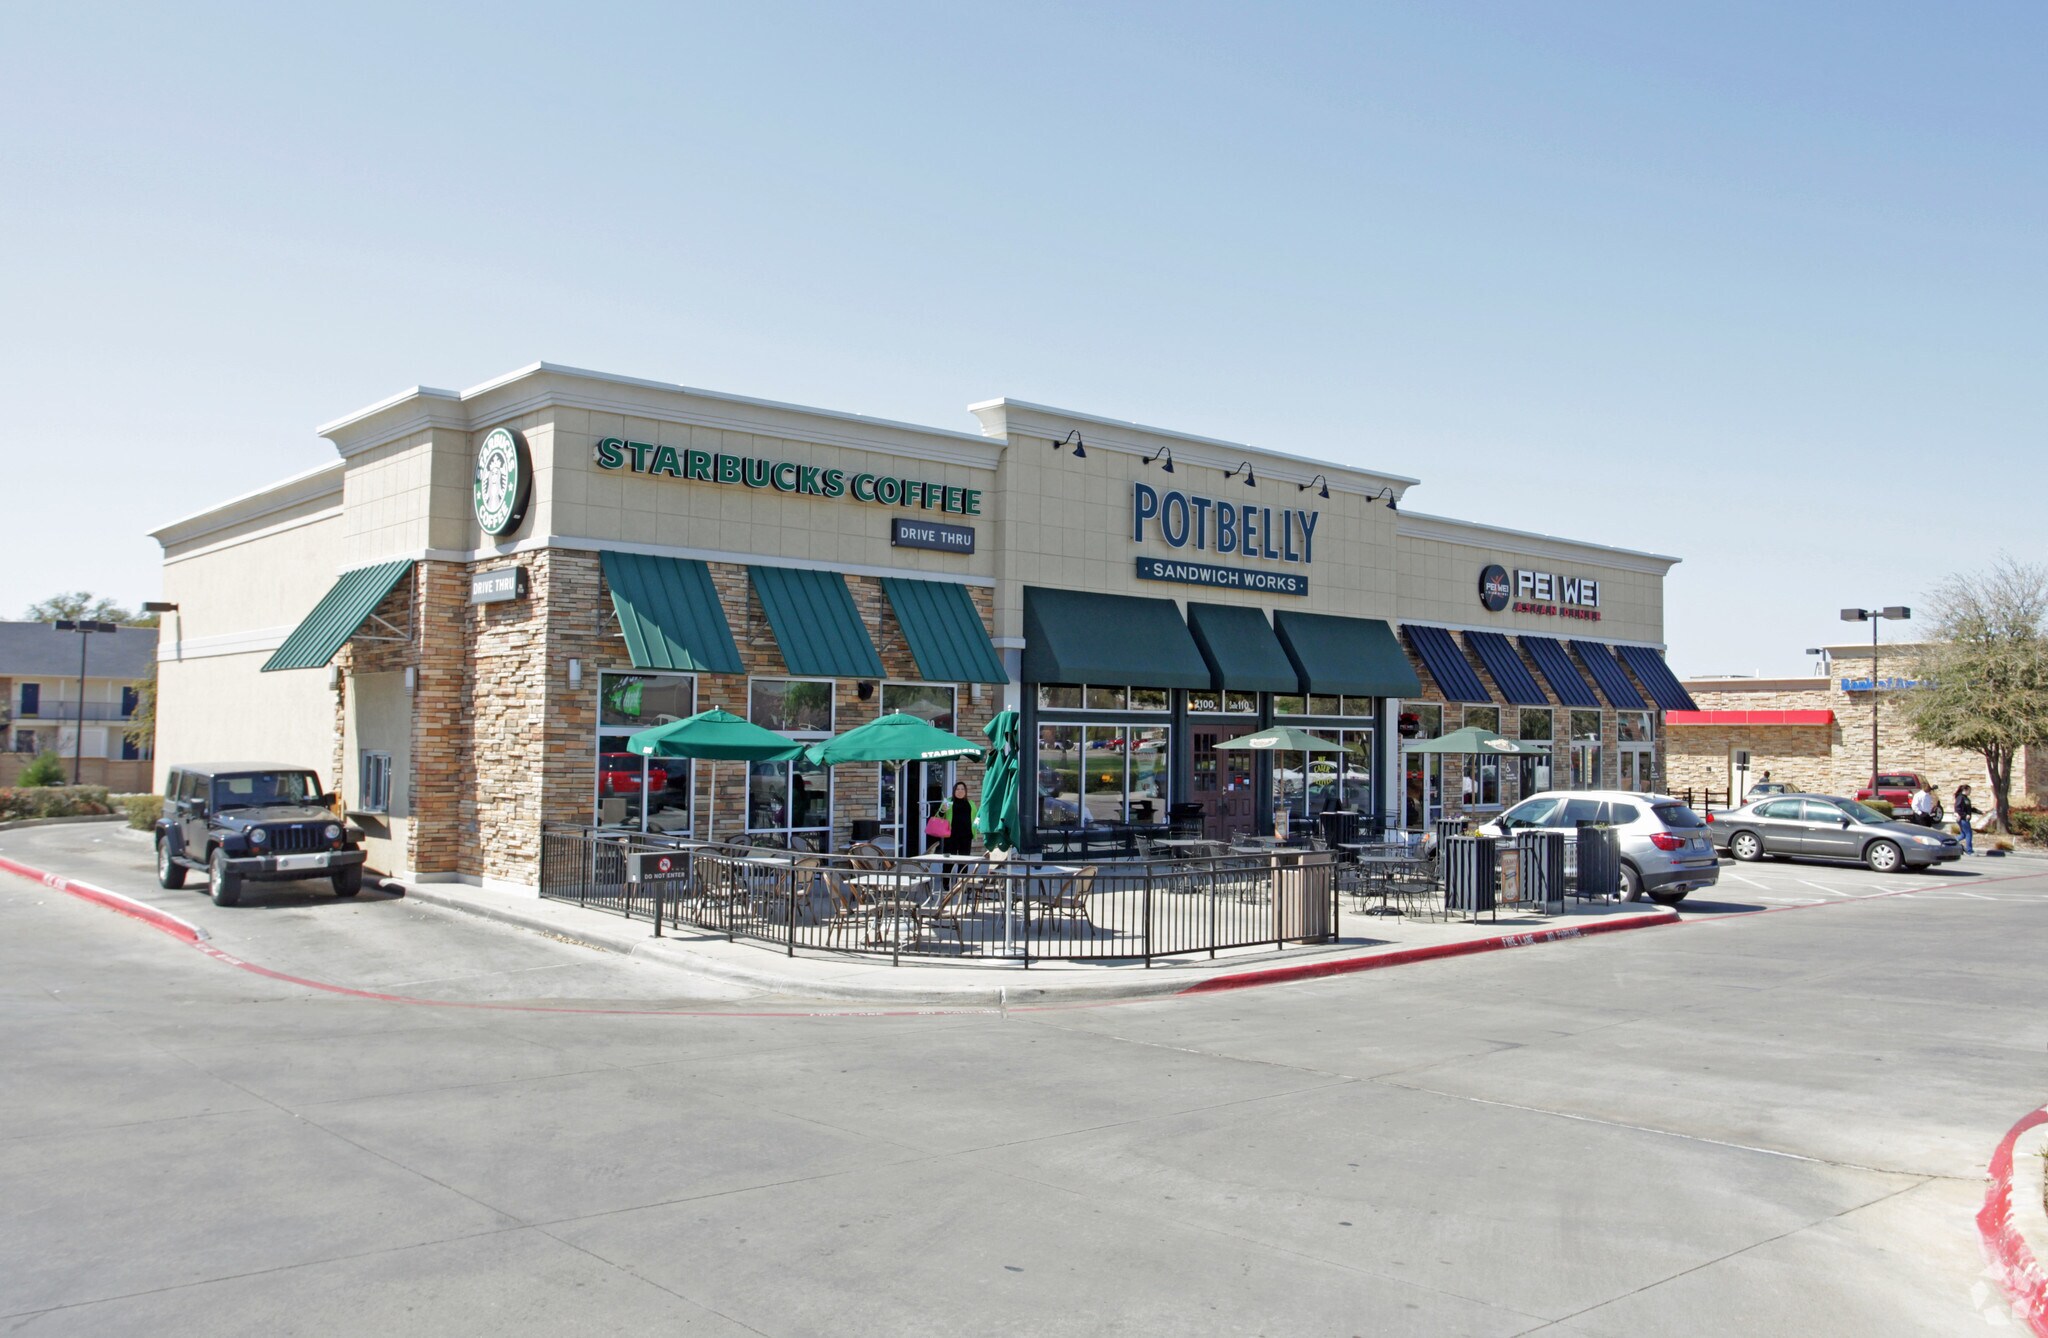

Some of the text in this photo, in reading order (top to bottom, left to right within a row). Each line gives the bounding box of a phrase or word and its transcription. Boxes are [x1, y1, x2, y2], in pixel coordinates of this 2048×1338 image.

[476, 433, 515, 481] STARBUCKS
[599, 436, 983, 516] STARBUCKS COFFEE
[479, 500, 509, 529] COFFEE
[1133, 480, 1320, 565] POTBELLY
[900, 527, 972, 546] DRIVE THRU
[473, 580, 494, 595] DRIVE
[495, 577, 515, 592] THRU
[1153, 562, 1297, 592] SANDWICH WORKS
[1486, 582, 1509, 592] PEI WEI
[1516, 569, 1600, 608] PEI WEI
[1514, 602, 1601, 621] ASIAN DINER
[1840, 677, 1873, 691] Bank
[1194, 699, 1215, 709] 2100
[921, 748, 981, 758] STARBUCKS
